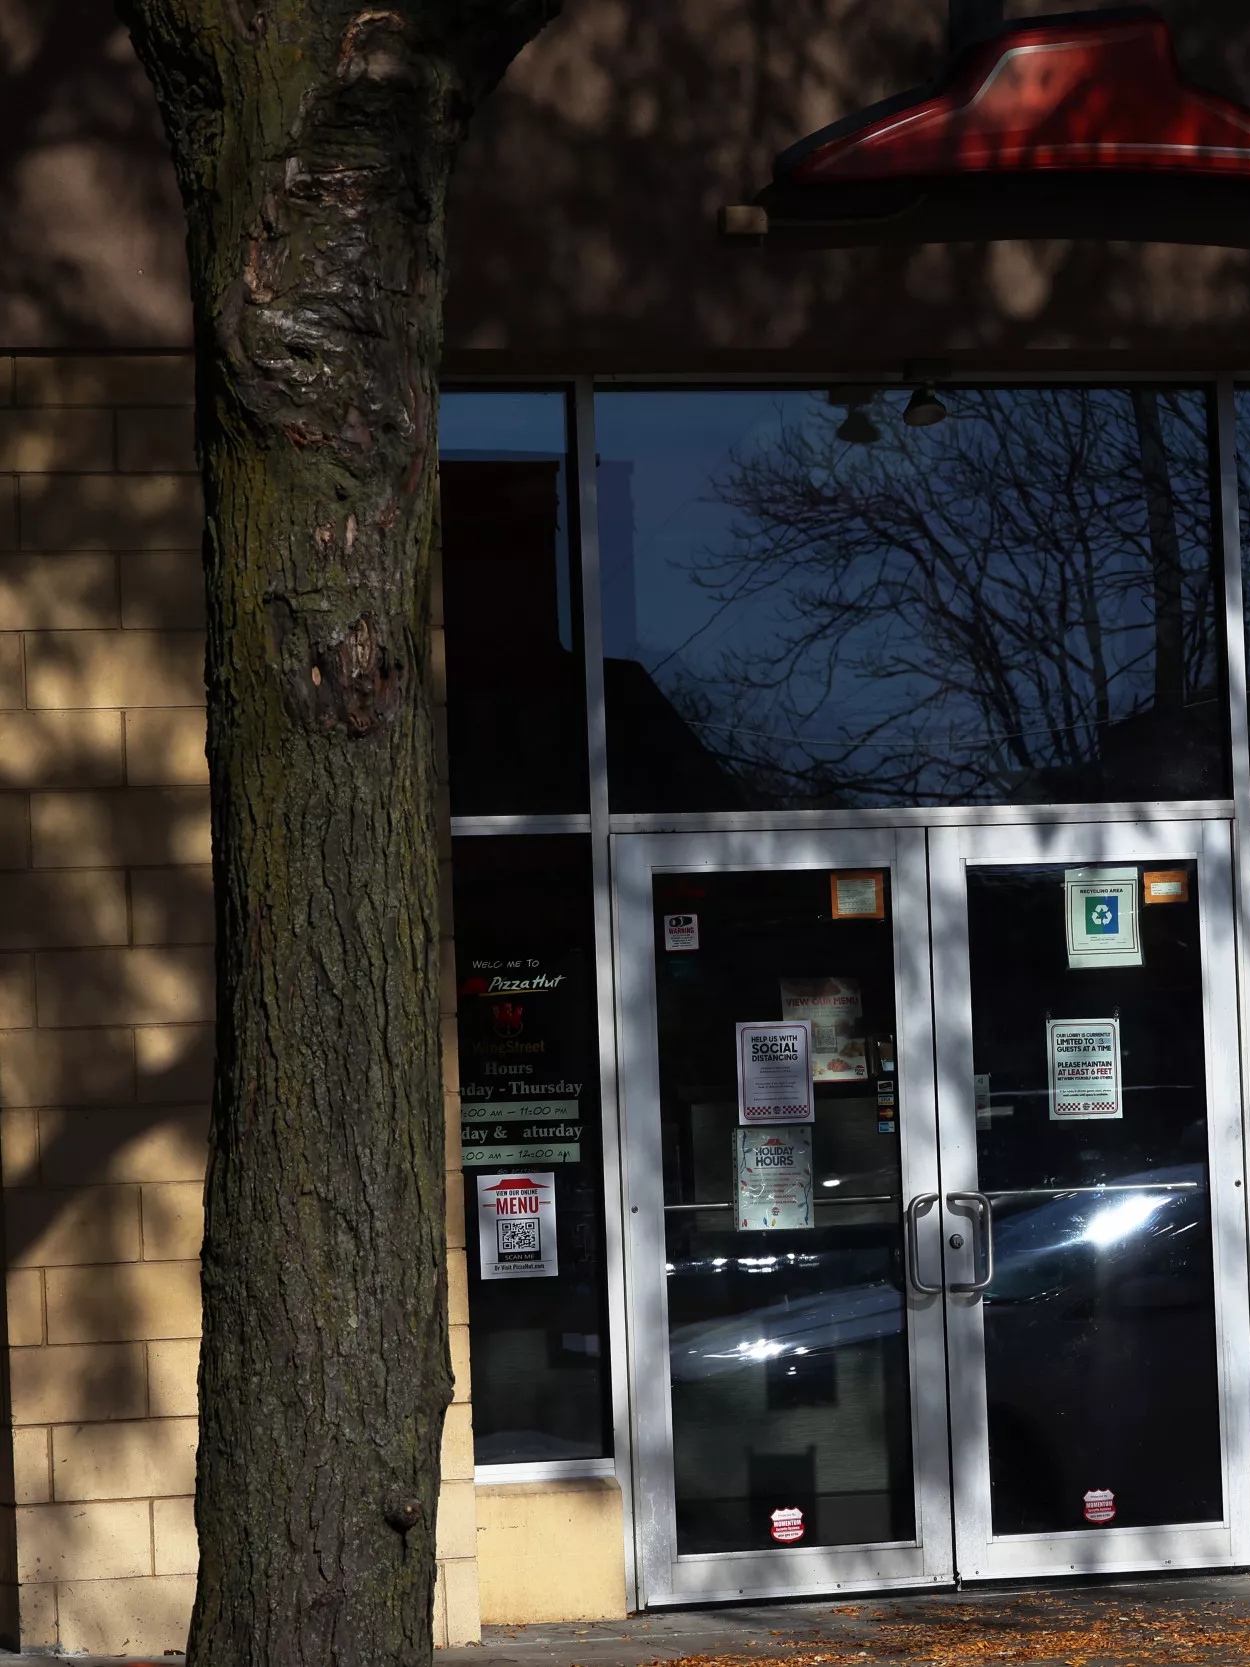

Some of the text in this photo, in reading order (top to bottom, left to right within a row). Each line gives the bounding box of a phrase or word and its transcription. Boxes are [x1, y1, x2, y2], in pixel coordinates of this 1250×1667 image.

[526, 959, 540, 967] TO
[488, 973, 567, 992] Pizza Hut
[787, 998, 810, 1007] VIEW
[833, 996, 859, 1006] MENU
[472, 1040, 546, 1056] WingStreet
[752, 1042, 798, 1055] SOCIAL
[752, 1053, 798, 1062] DISTANCING
[484, 1062, 533, 1075] Hours
[508, 1080, 583, 1097] Thursday
[493, 1125, 507, 1139] &
[462, 1151, 484, 1160] :00
[519, 1149, 553, 1158] 12:00
[755, 1146, 794, 1156] HOLIDAY
[755, 1156, 794, 1167] HOURS
[496, 1196, 540, 1215] MENU
